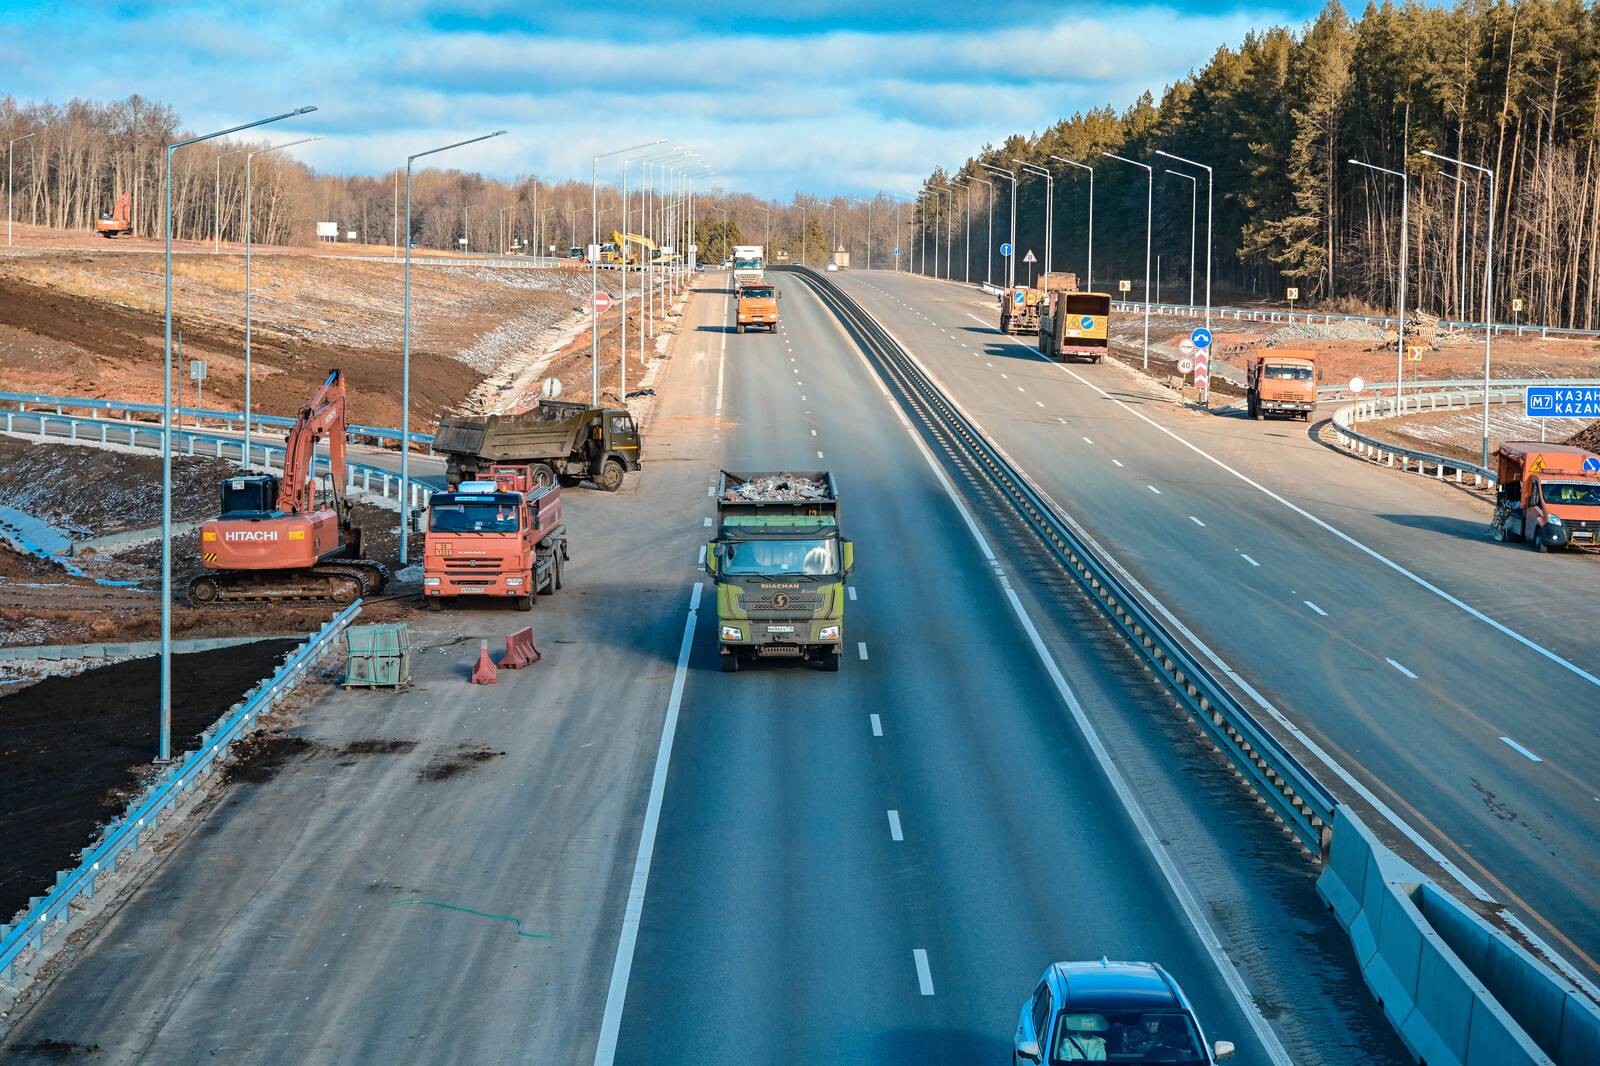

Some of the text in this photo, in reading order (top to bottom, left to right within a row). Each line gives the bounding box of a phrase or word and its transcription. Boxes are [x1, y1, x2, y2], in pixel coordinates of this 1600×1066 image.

[1180, 361, 1191, 370] 40
[1555, 403, 1600, 414] KAZAN
[225, 531, 278, 541] HITACHI
